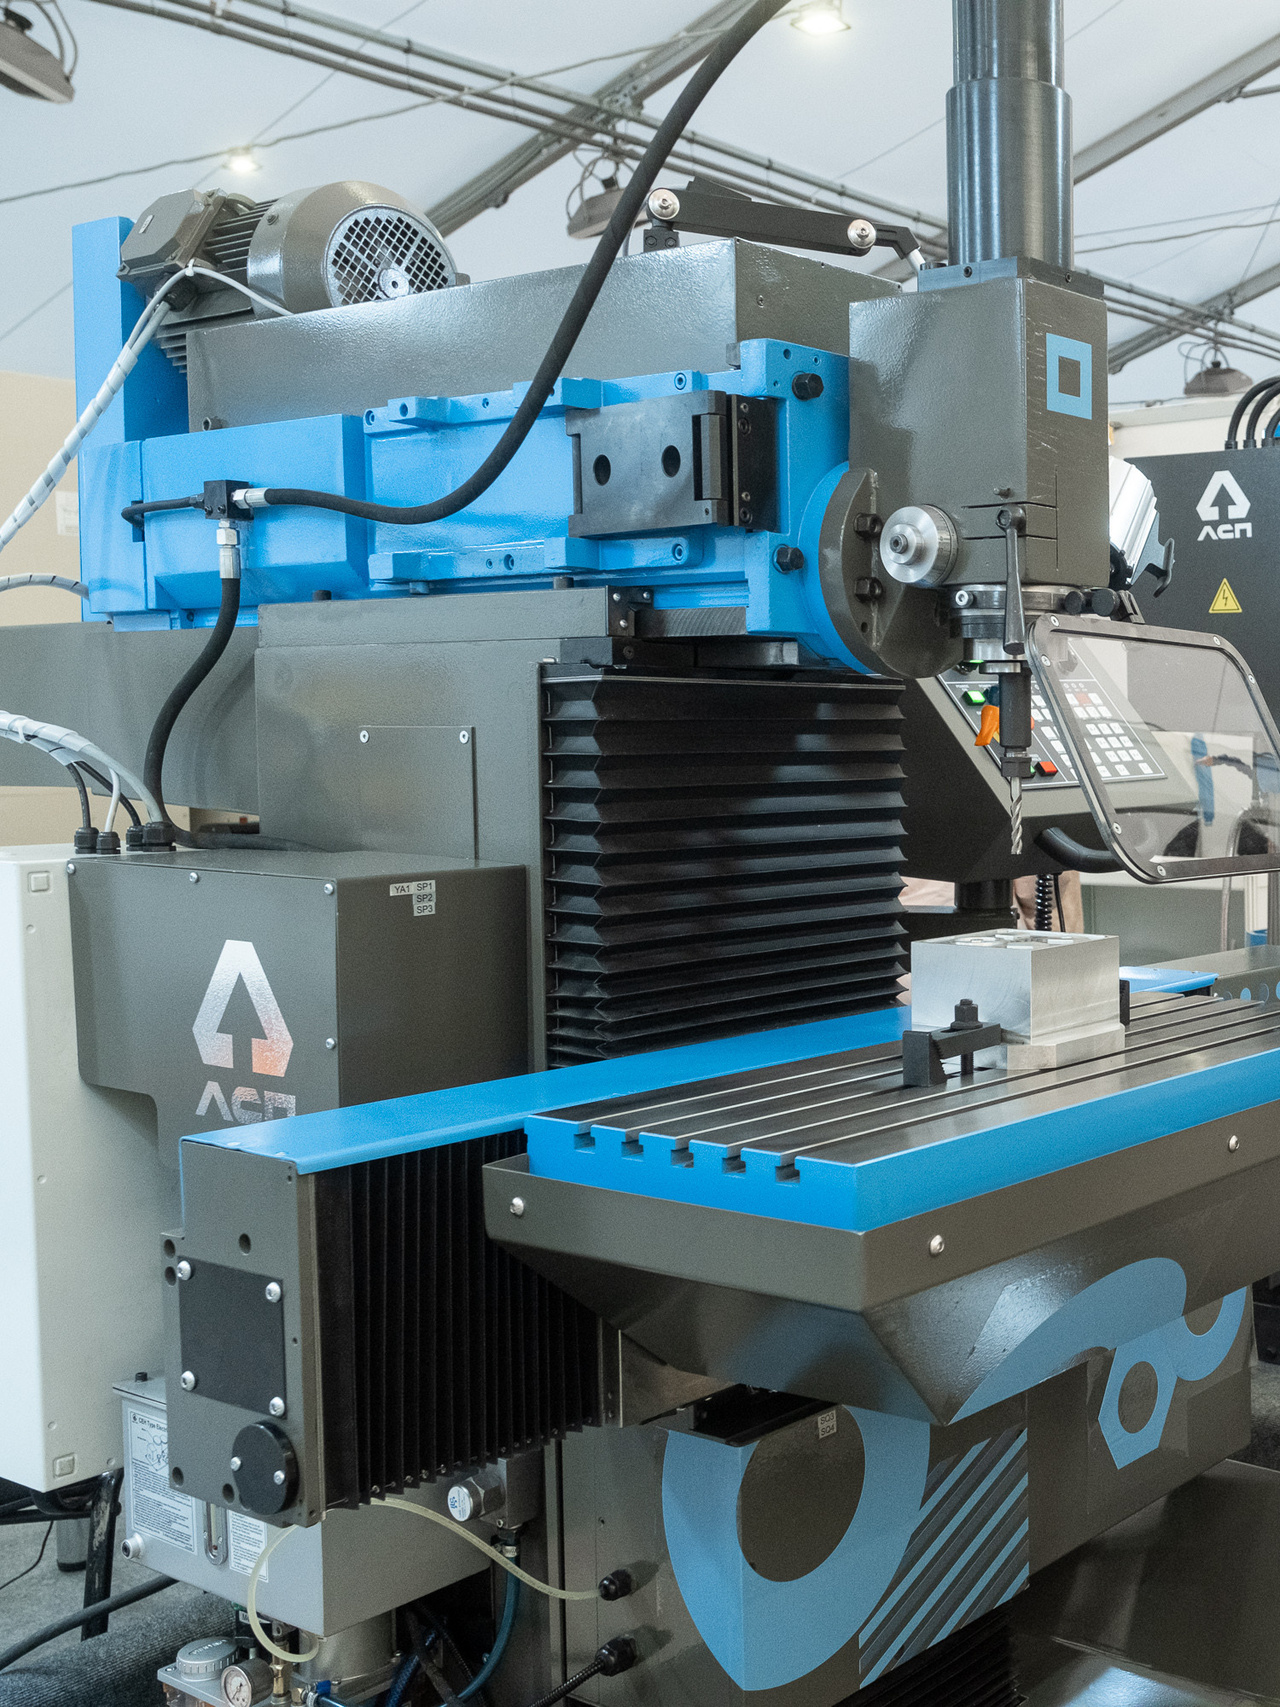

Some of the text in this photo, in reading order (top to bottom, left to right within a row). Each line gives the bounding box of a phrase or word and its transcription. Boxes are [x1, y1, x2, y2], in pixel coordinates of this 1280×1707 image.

[394, 885, 410, 893] YA1
[416, 882, 432, 891] SP1
[416, 894, 433, 902] SP2
[416, 905, 433, 914] SP3
